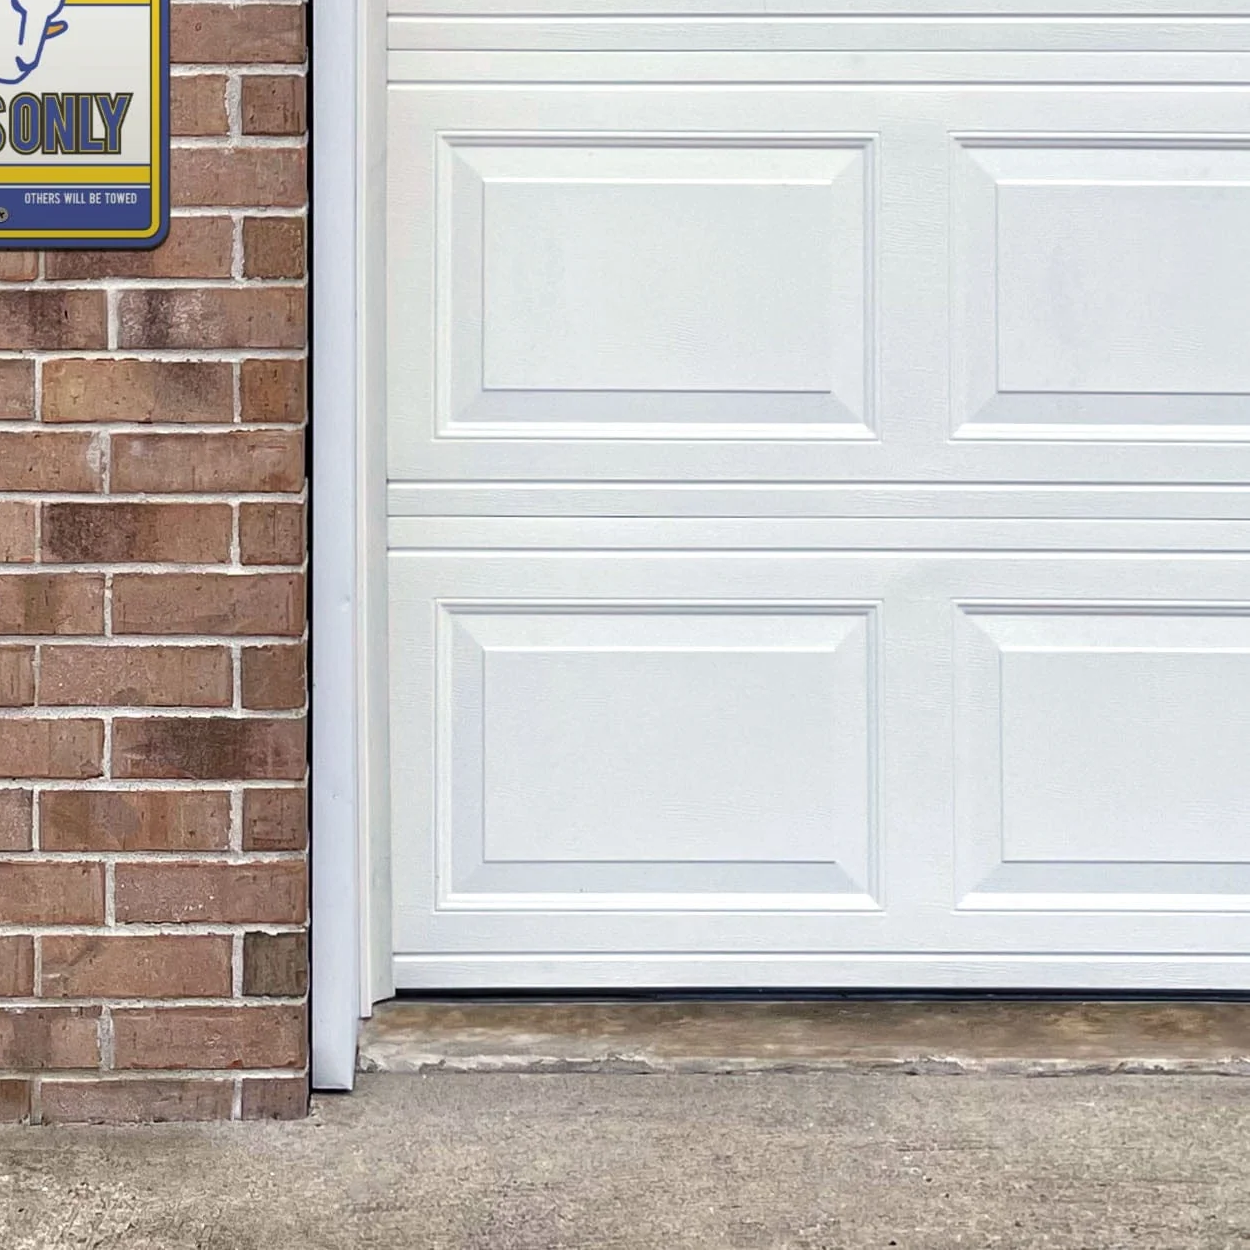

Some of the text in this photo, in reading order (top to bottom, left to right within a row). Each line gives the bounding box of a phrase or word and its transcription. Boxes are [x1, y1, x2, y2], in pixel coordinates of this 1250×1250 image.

[8, 92, 133, 155] ONLY
[24, 192, 138, 205] OTHERS WILL BE TOWED
